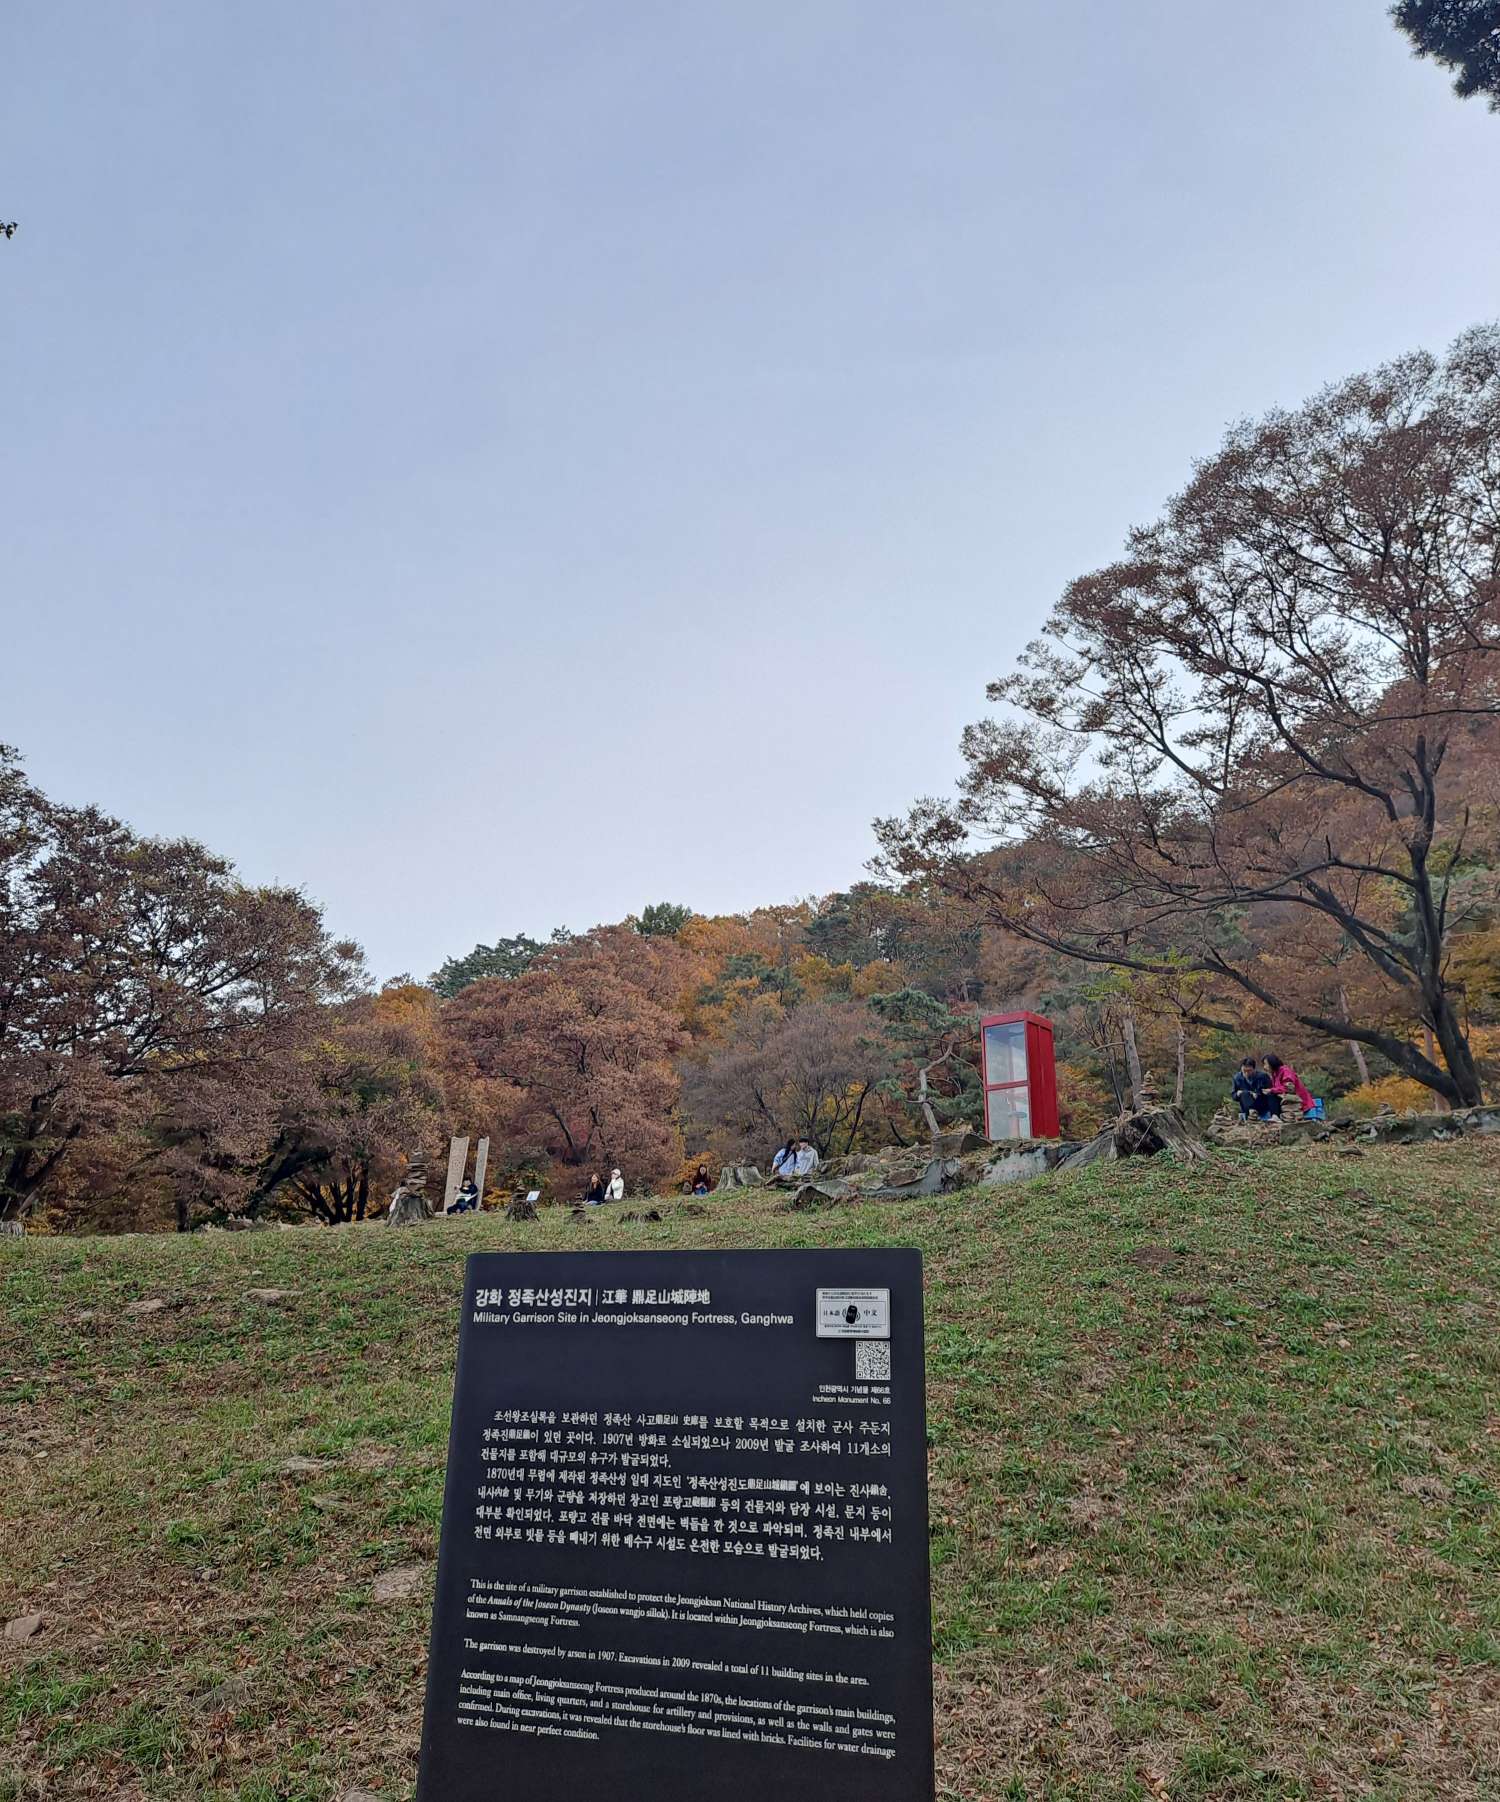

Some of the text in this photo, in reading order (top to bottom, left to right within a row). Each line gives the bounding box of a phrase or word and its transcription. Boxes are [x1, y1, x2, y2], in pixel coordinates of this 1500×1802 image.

[475, 1288, 592, 1307] 강화 정족산성진지
[601, 1288, 628, 1304] 江華
[473, 1311, 510, 1325] Military
[512, 1311, 555, 1323] Garrison
[557, 1311, 577, 1323] Site
[579, 1311, 589, 1323] in
[692, 1311, 738, 1325] Fortress,
[740, 1312, 794, 1326] Ganghwa
[818, 1384, 849, 1394] 인천광역시
[812, 1394, 836, 1403] Incheon
[837, 1396, 869, 1404] Monument
[870, 1396, 881, 1405] No.
[470, 1578, 486, 1589] This
[531, 1583, 559, 1597] military
[559, 1586, 588, 1598] garrison
[588, 1588, 628, 1600] established
[637, 1593, 663, 1604] protect
[676, 1594, 722, 1608] Jeongjoksan
[722, 1597, 756, 1610] National
[757, 1600, 787, 1615] History
[824, 1605, 849, 1617] which
[849, 1607, 867, 1619] held
[868, 1610, 894, 1623] copies
[466, 1607, 489, 1619] known
[559, 1600, 591, 1615] Dynasty
[619, 1606, 645, 1619] wangjo
[686, 1610, 713, 1622] located
[714, 1613, 738, 1624] within
[809, 1620, 844, 1635] Fortress,
[844, 1623, 869, 1636] which
[878, 1626, 894, 1638] also
[463, 1638, 478, 1649] The
[479, 1640, 507, 1652] garrison
[522, 1643, 556, 1658] destroyed
[567, 1650, 587, 1659] arson
[598, 1650, 617, 1662] 1907.
[618, 1652, 661, 1666] Excavations
[671, 1657, 691, 1668] 2009
[691, 1660, 723, 1672] revealed
[730, 1663, 749, 1674] total
[761, 1665, 769, 1676] 11
[771, 1666, 804, 1682] building
[805, 1670, 824, 1681] sites
[460, 1668, 496, 1684] According
[508, 1676, 525, 1687] map
[595, 1681, 624, 1694] Fortress
[624, 1685, 659, 1698] produced
[659, 1690, 686, 1700] around
[738, 1695, 773, 1709] locations
[834, 1707, 855, 1718] main
[459, 1683, 492, 1699] including
[535, 1691, 555, 1706] living
[611, 1700, 651, 1713] storehouse
[666, 1706, 696, 1720] artillery
[768, 1716, 784, 1727] well
[812, 1721, 833, 1733] walls
[852, 1727, 874, 1738] gates
[875, 1730, 896, 1739] were
[457, 1717, 474, 1726] were
[474, 1716, 489, 1727] also
[489, 1717, 511, 1730] found
[519, 1724, 536, 1733] near
[536, 1724, 562, 1736] perfect
[495, 1702, 520, 1718] During
[583, 1714, 613, 1725] revealed
[613, 1715, 628, 1727] that
[687, 1723, 706, 1736] floor
[721, 1727, 741, 1740] lined
[742, 1730, 760, 1742] with
[787, 1734, 823, 1748] Facilities
[837, 1743, 860, 1753] water
[860, 1742, 896, 1760] drainage
